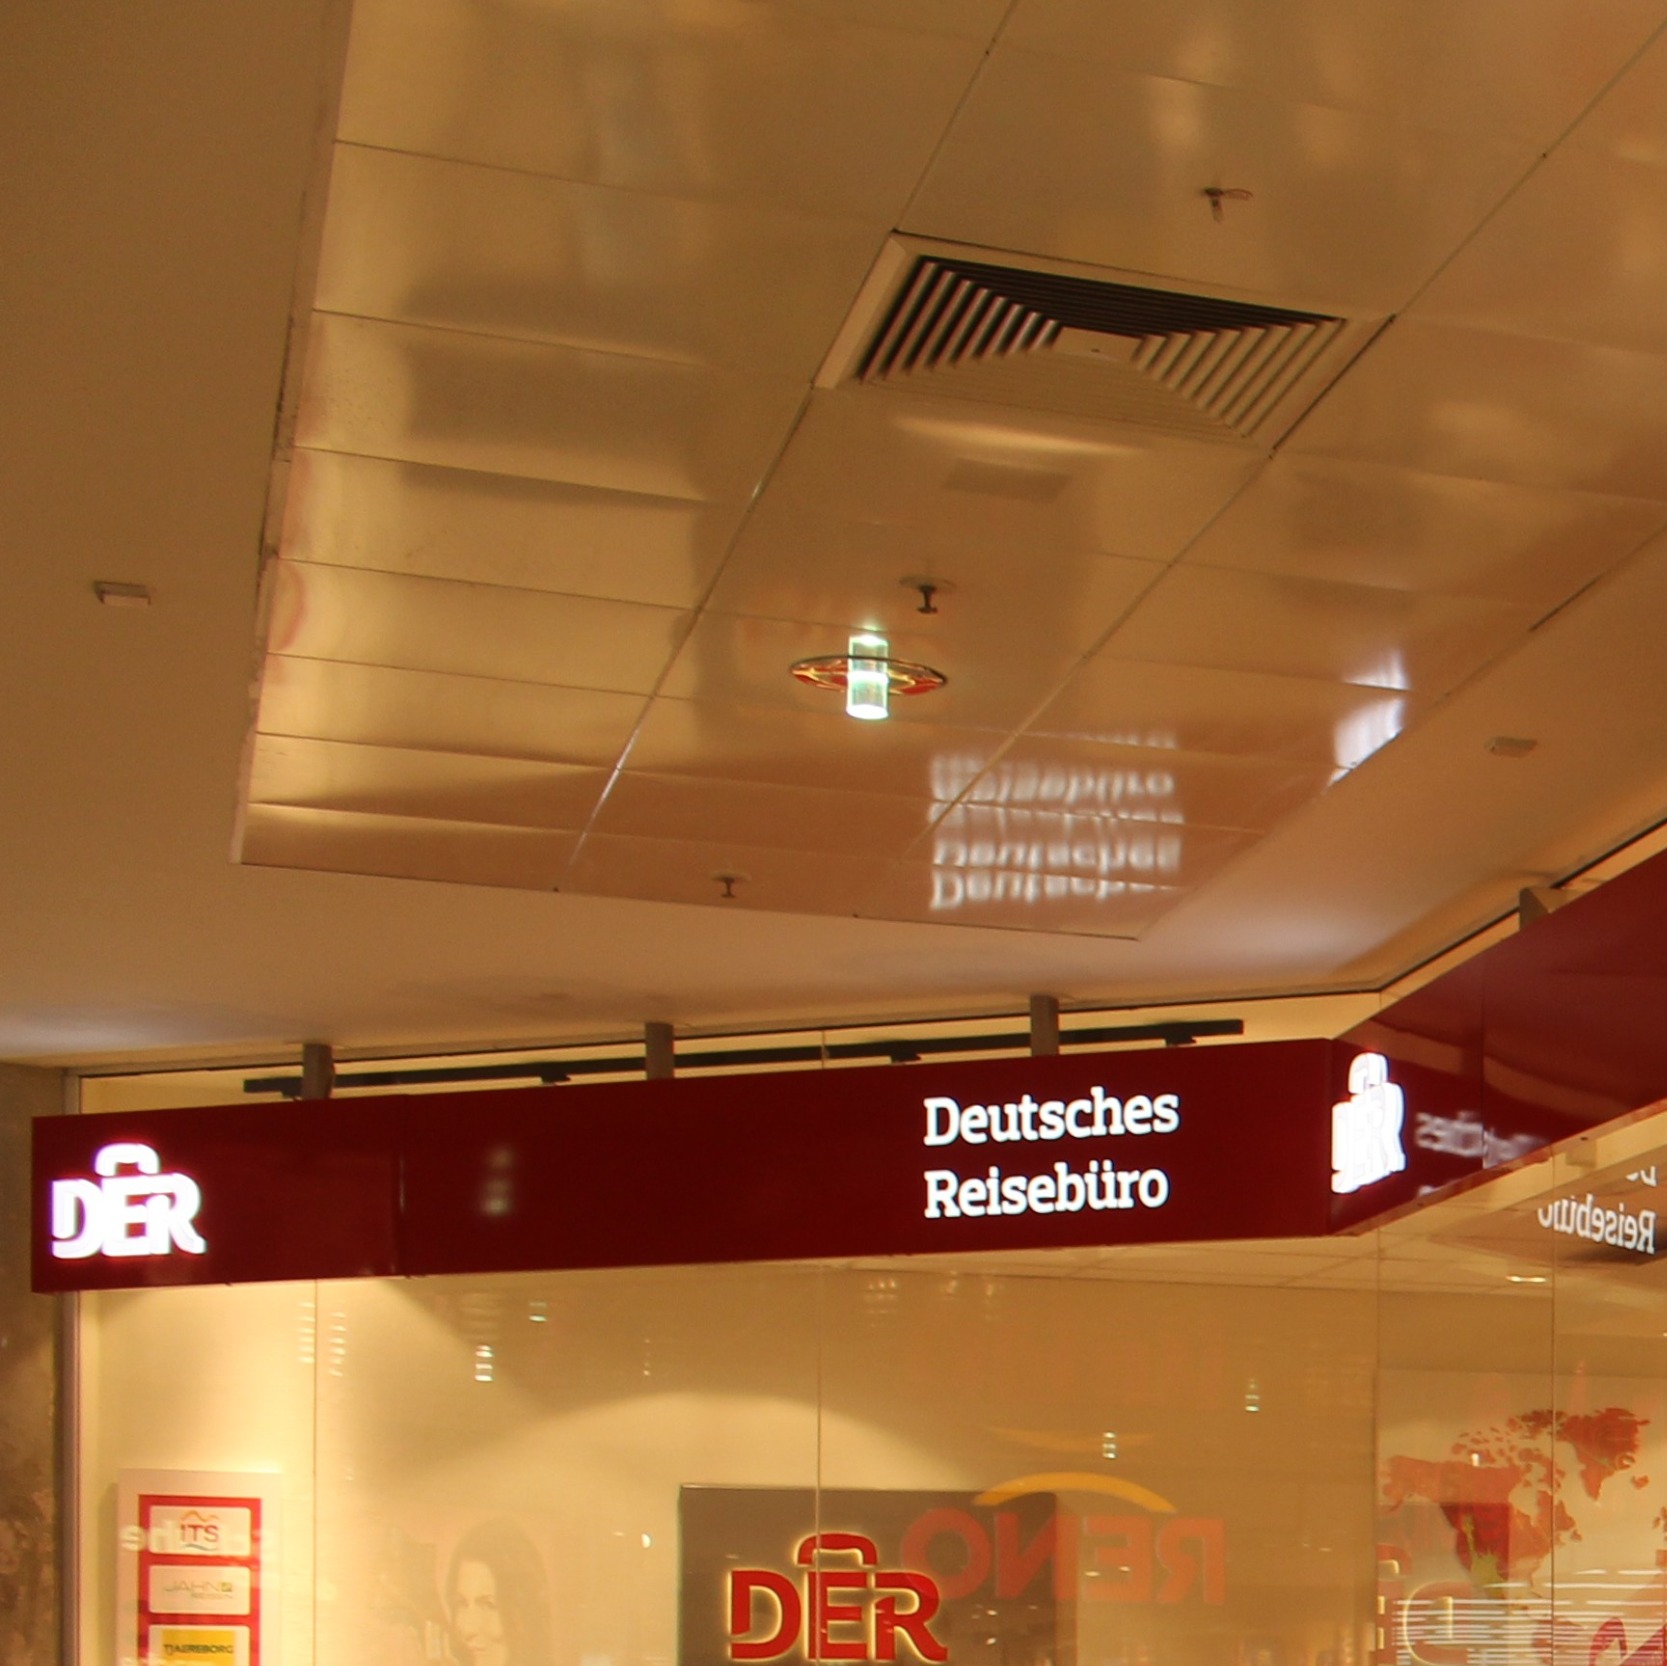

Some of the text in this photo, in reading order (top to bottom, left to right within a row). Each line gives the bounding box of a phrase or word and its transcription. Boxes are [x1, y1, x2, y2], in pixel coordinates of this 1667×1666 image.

[924, 1086, 1180, 1147] Deutsches
[51, 1170, 207, 1260] DER
[924, 1161, 1169, 1219] Reisebüro
[180, 1524, 219, 1542] ITS
[730, 1569, 948, 1661] DER
